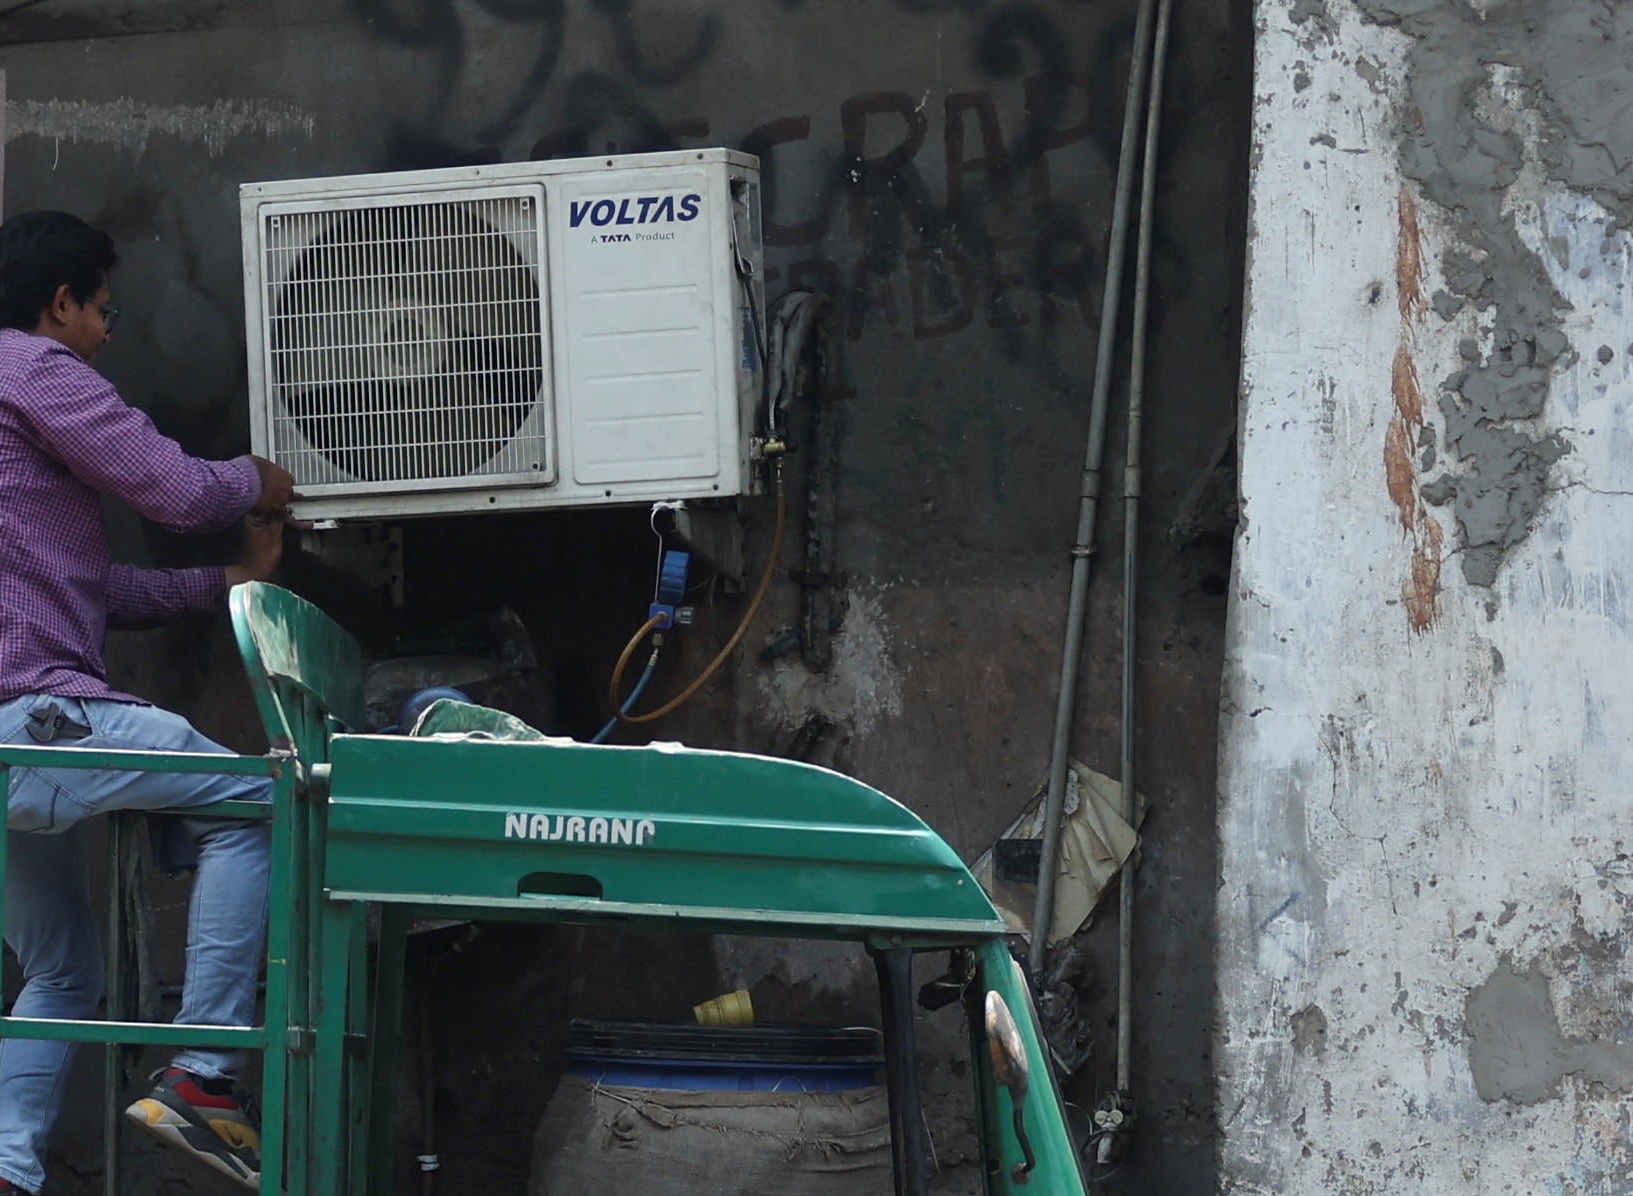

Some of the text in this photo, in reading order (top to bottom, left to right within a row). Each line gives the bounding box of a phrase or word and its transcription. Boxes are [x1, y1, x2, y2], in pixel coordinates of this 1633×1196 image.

[569, 194, 702, 228] VOLTAS
[591, 232, 675, 244] A TATA Product
